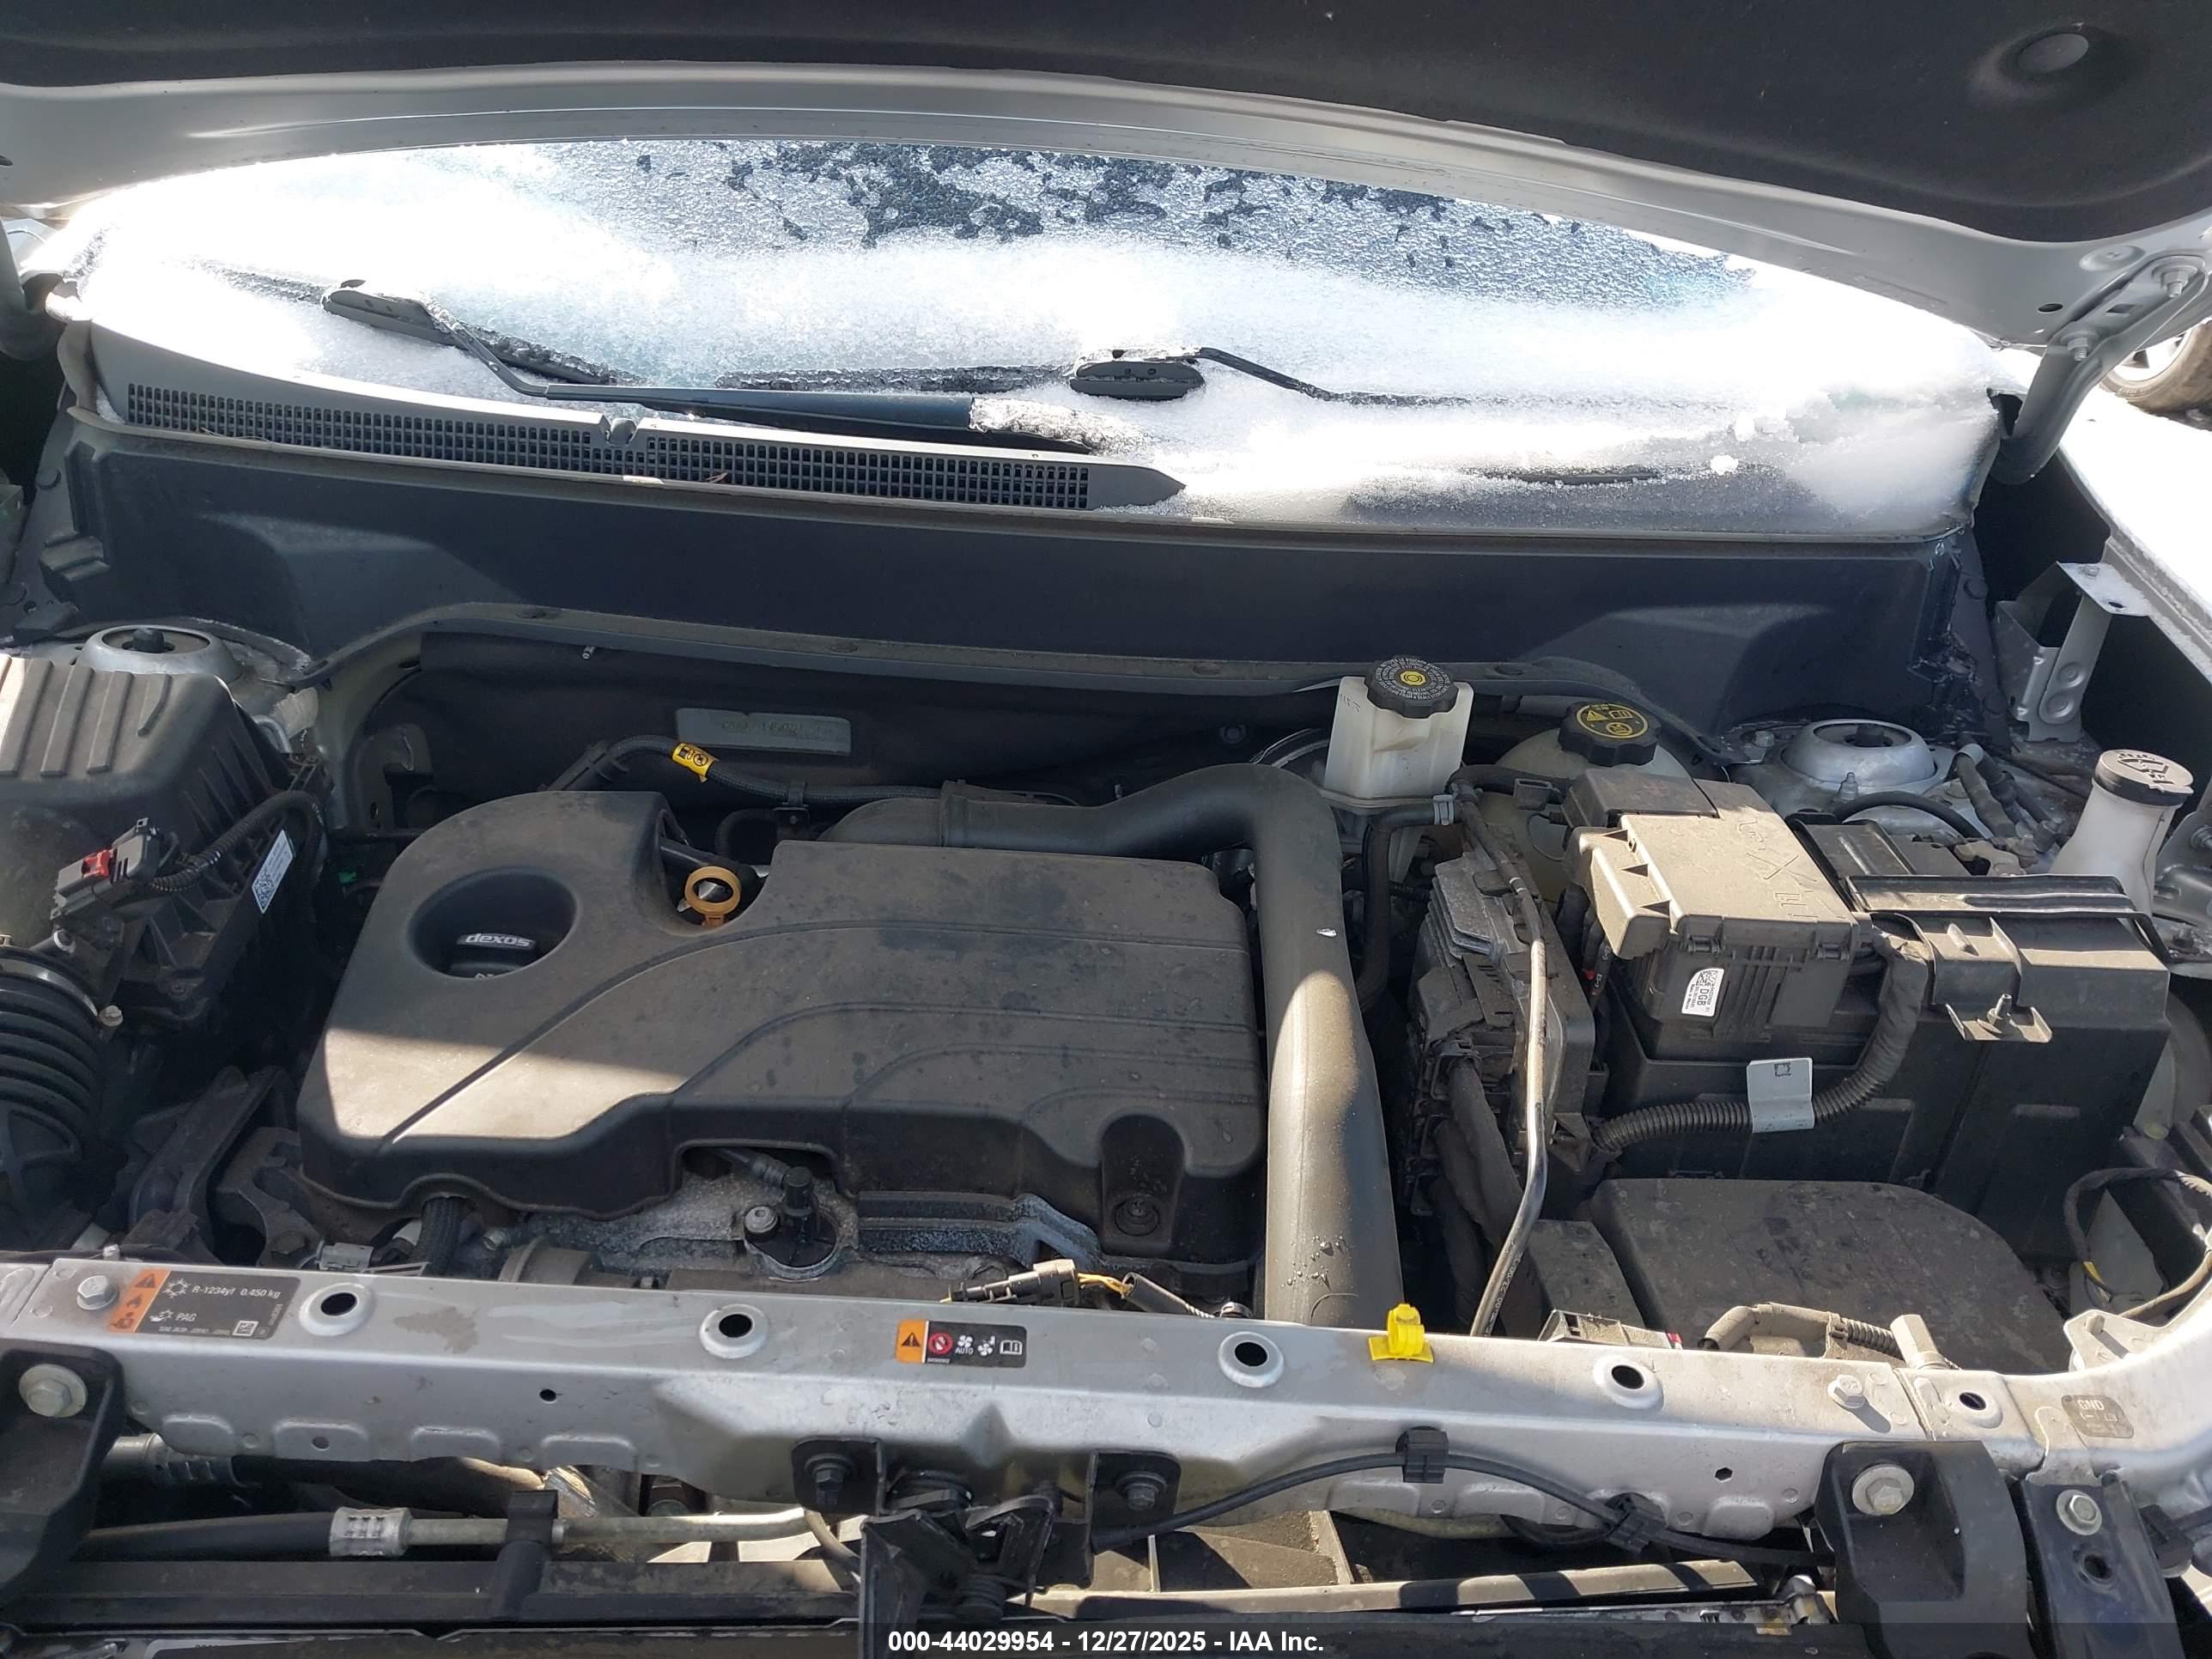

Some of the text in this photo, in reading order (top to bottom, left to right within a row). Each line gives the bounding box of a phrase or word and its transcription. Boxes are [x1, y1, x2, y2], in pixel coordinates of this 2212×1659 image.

[465, 933, 530, 947] dexos
[1697, 988, 1710, 1006] DGB
[191, 1285, 281, 1298] R-1234yf 0.450 kg
[175, 1313, 197, 1322] PAG
[954, 1346, 974, 1355] AUTO
[2077, 1400, 2105, 1410] GND
